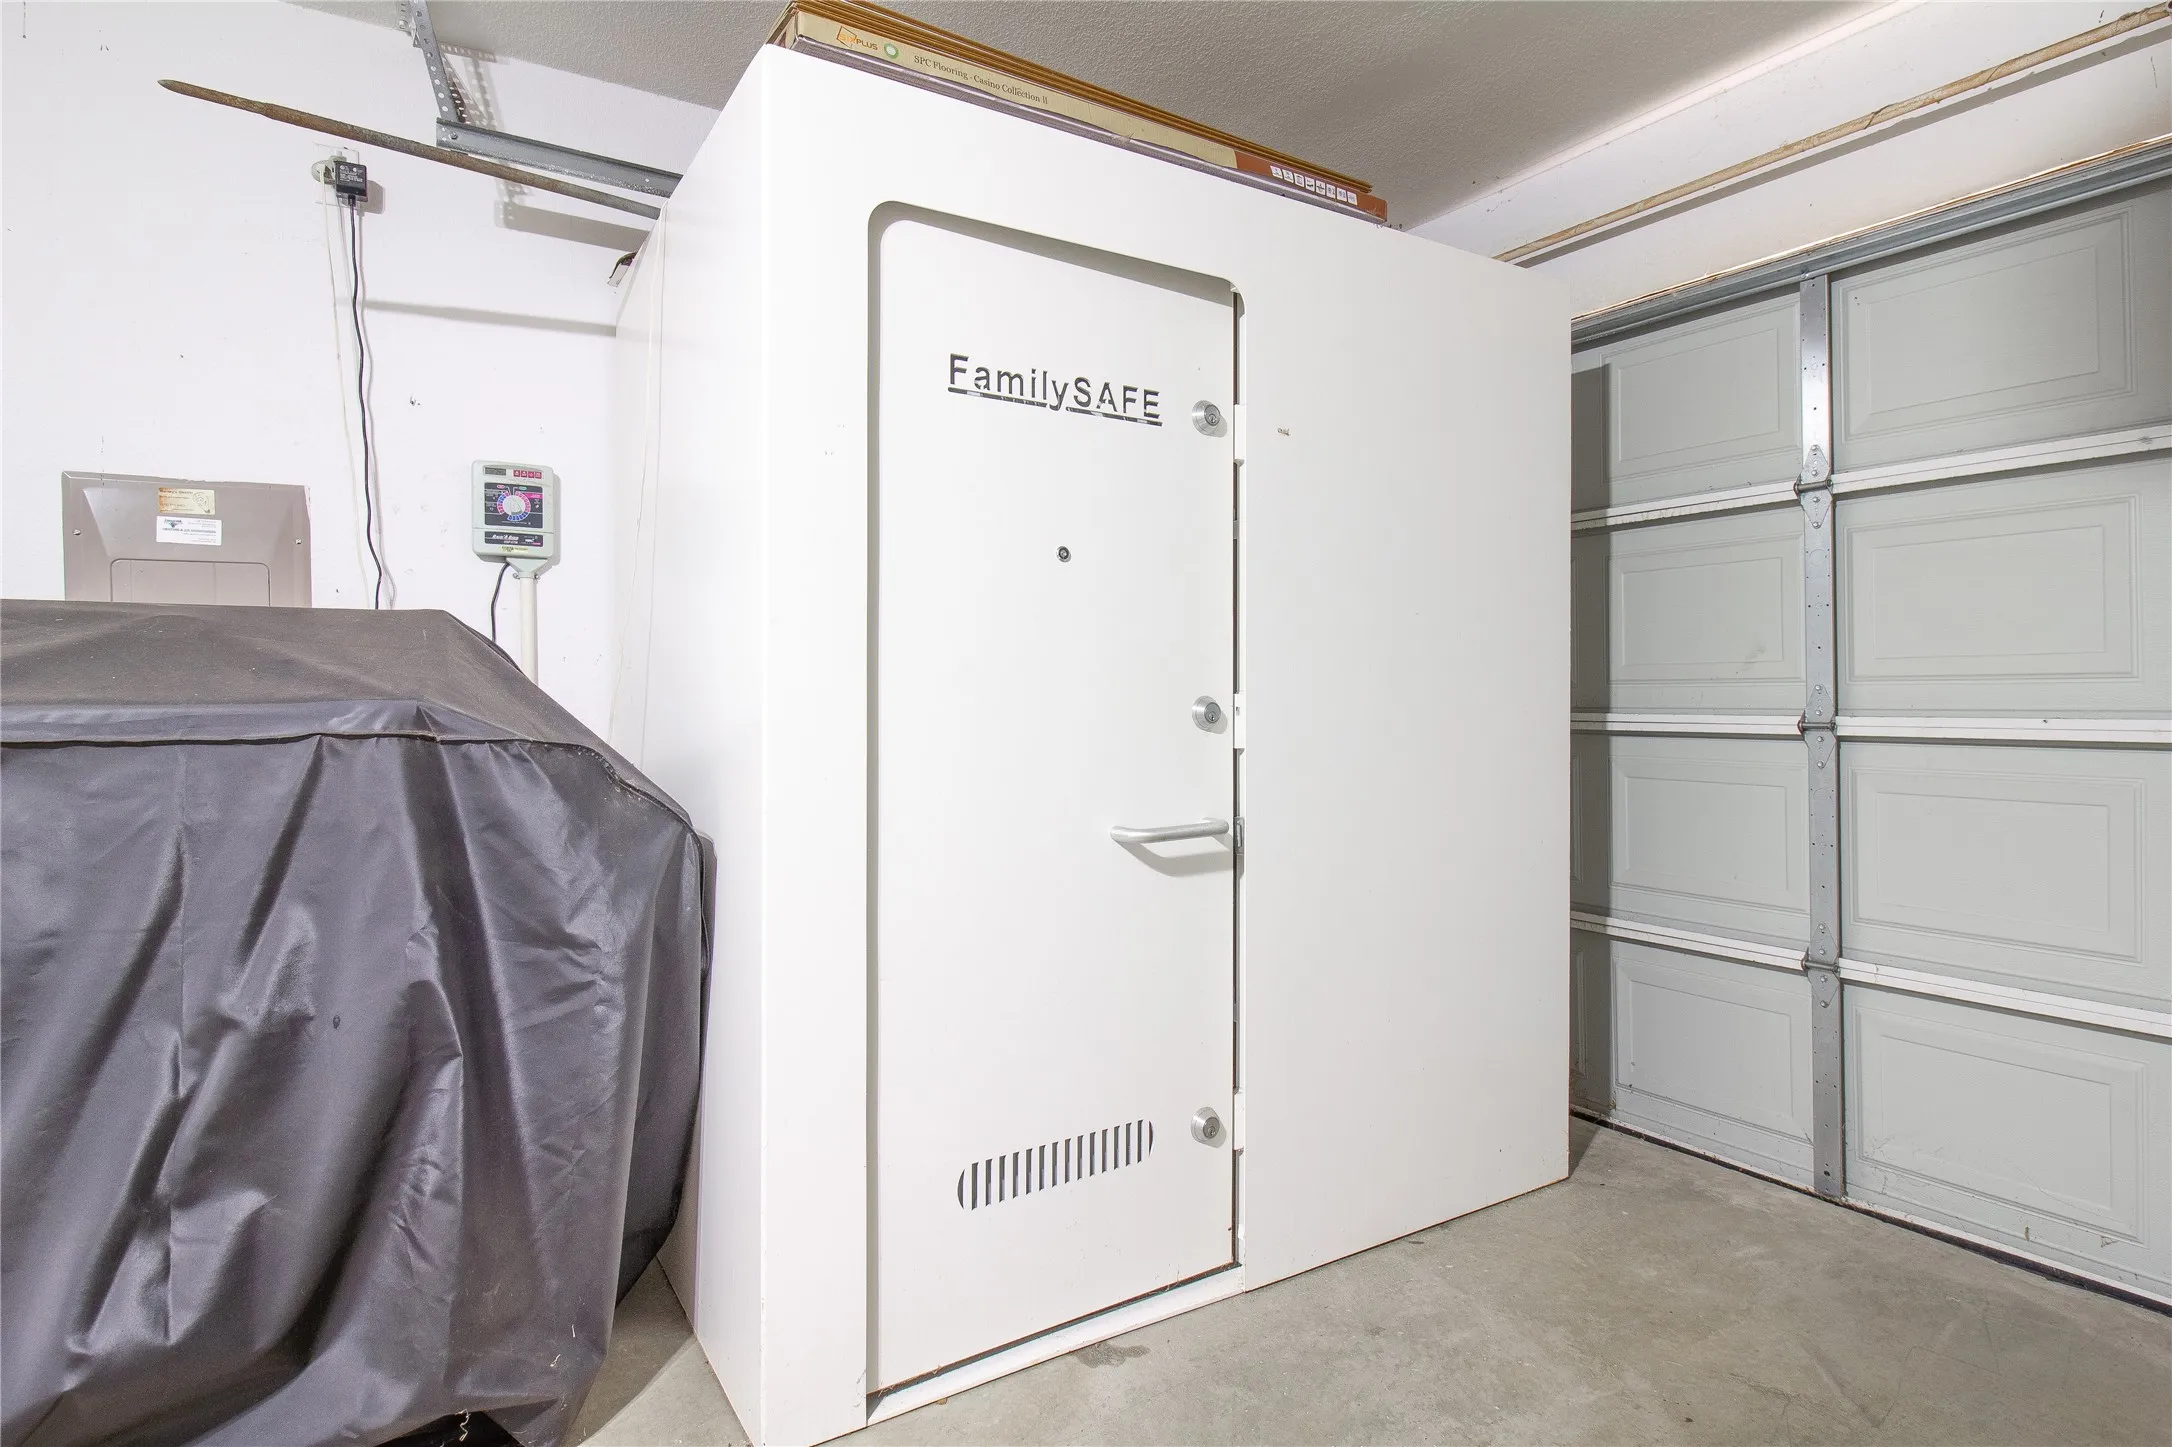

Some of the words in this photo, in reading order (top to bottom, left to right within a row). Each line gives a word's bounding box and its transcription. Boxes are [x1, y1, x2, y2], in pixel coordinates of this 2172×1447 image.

[914, 55, 931, 67] SPC
[933, 61, 969, 80] Flooring
[973, 74, 1000, 90] Casino
[1001, 83, 1040, 102] Collection
[949, 353, 1161, 419] FamilySAFE
